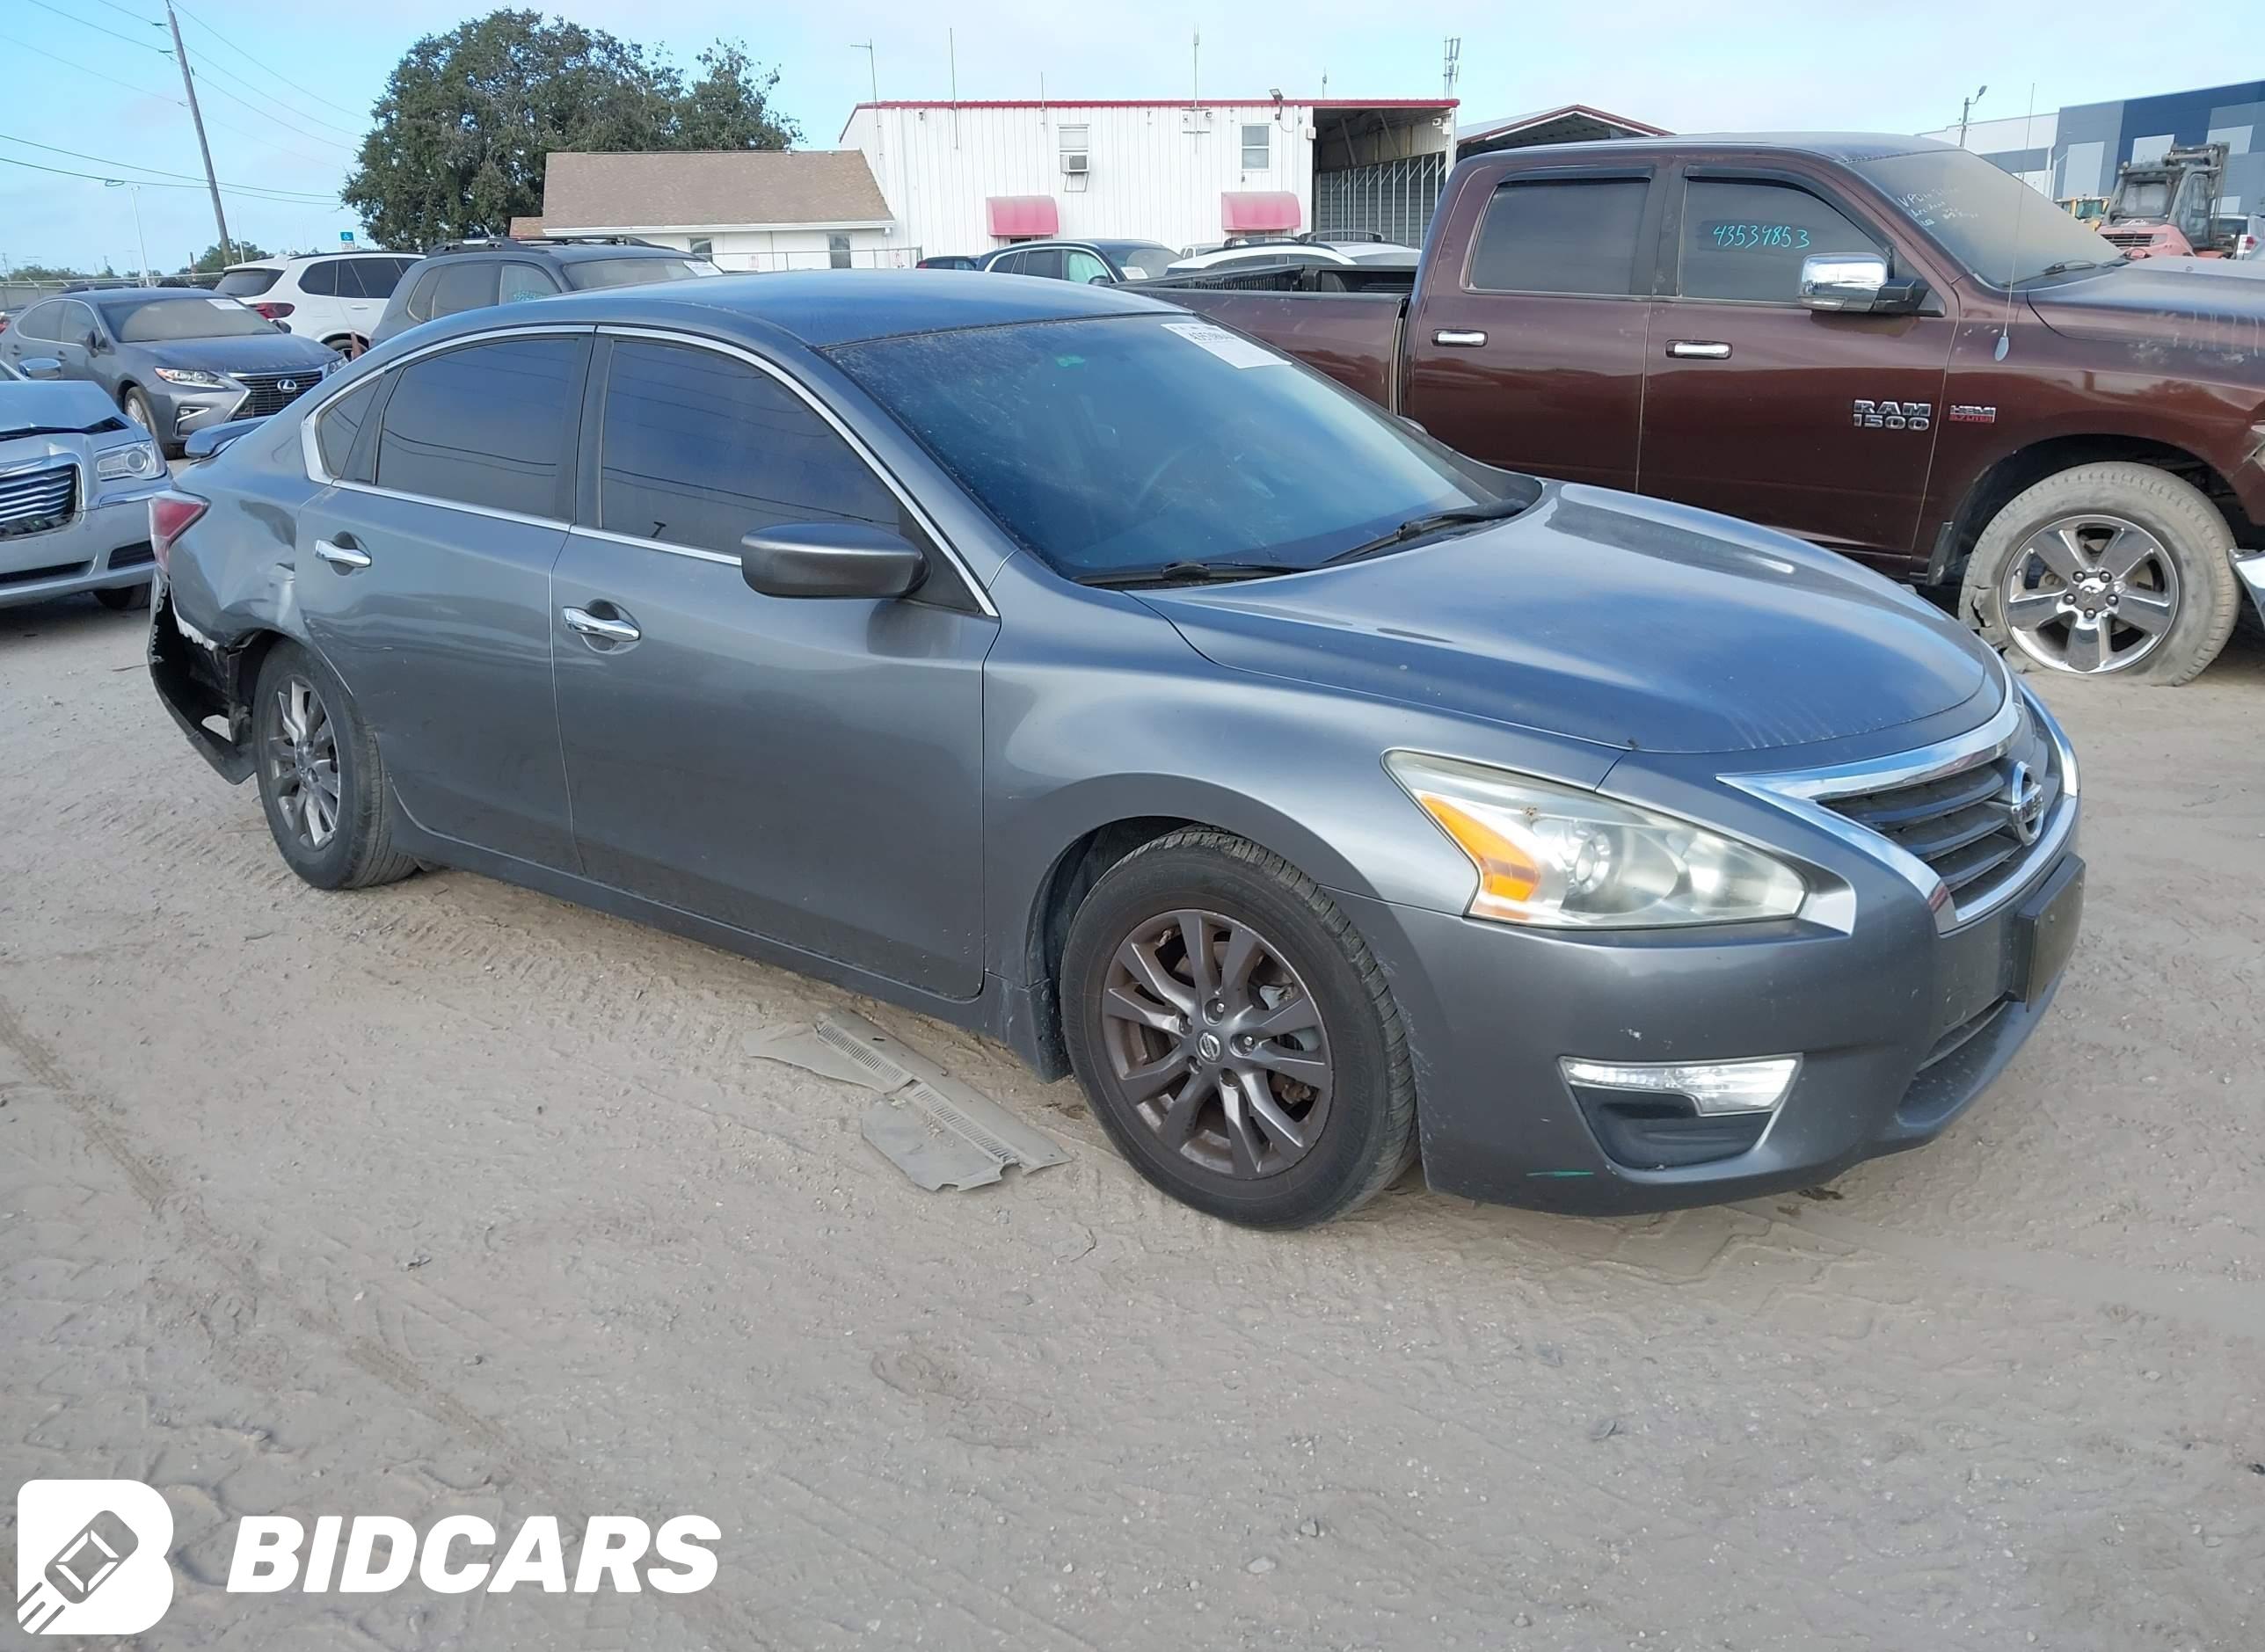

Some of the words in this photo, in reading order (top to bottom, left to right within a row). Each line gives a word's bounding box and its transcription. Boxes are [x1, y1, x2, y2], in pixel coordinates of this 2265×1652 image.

[1853, 399, 1932, 417] RAM
[1949, 404, 1996, 417] HEMI
[1853, 413, 1930, 431] 1500
